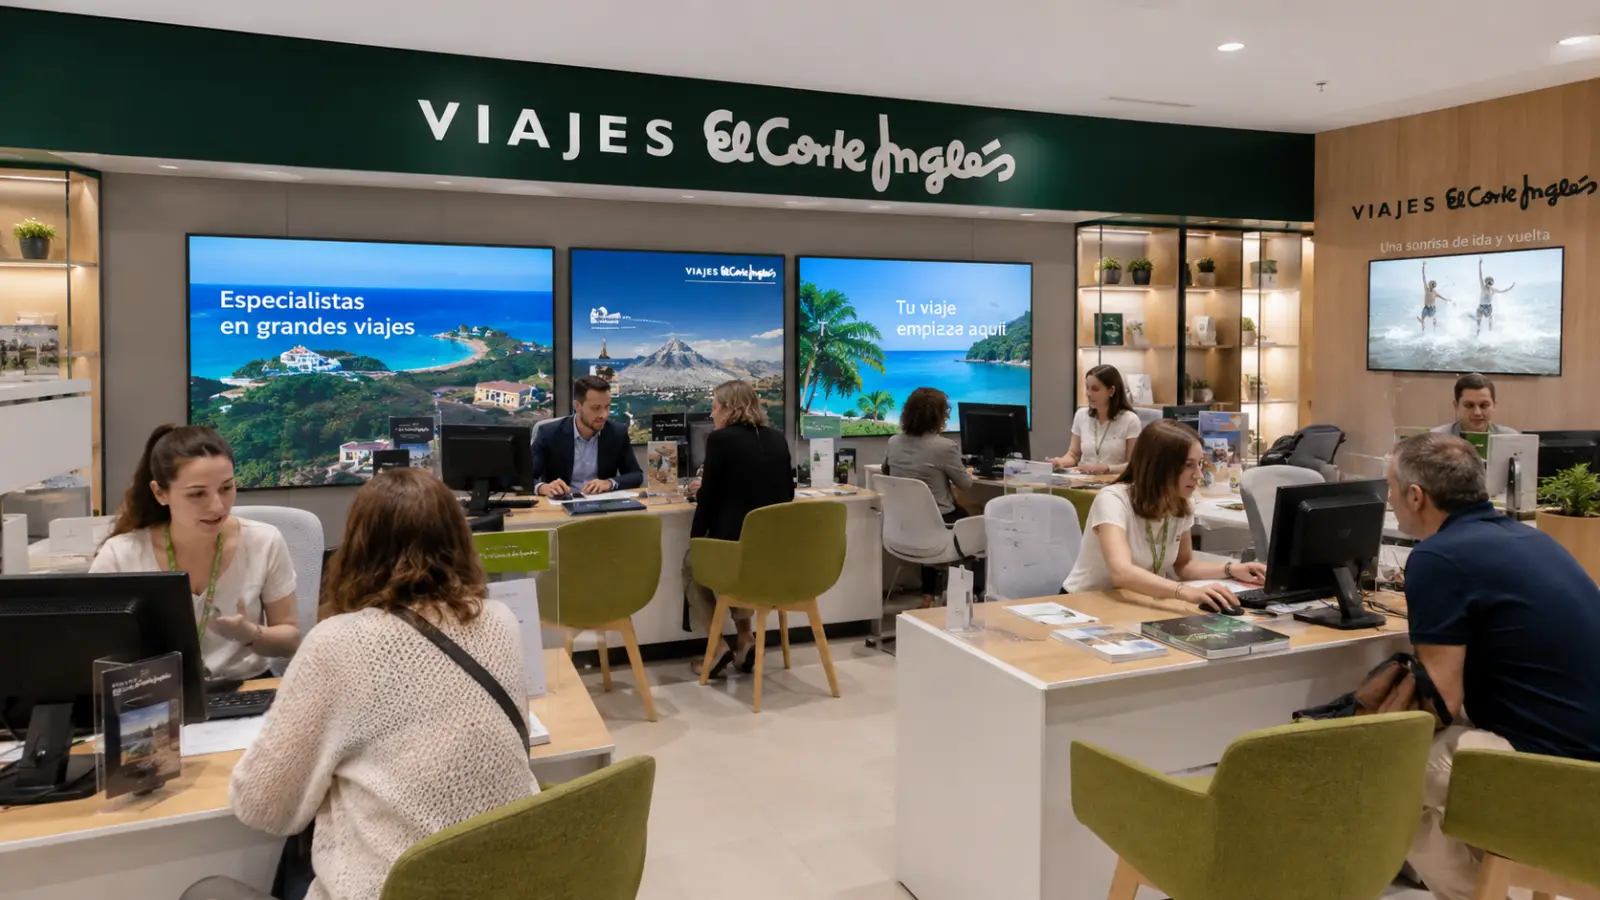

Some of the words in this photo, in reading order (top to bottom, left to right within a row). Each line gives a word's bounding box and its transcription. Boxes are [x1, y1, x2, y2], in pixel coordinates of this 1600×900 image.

[417, 99, 674, 161] VIAJES
[703, 109, 754, 163] El
[757, 117, 866, 172] Corte
[872, 113, 1016, 194] Inglés
[1352, 197, 1435, 220] VIAJES
[1446, 187, 1465, 210] El
[1467, 186, 1517, 207] Corte
[1520, 174, 1598, 210] Inglés
[1380, 242, 1402, 253] Una
[1406, 237, 1449, 252] sonrisa
[1452, 236, 1469, 248] de
[1472, 233, 1492, 246] ida
[1496, 235, 1503, 247] y
[1507, 229, 1551, 244] vuelta
[685, 266, 719, 278] VIAJES
[220, 290, 365, 313] Especialistas
[896, 299, 916, 315] Tu
[920, 300, 957, 318] viaje
[220, 320, 249, 335] en
[257, 317, 347, 340] grandes
[354, 317, 415, 340] viajes
